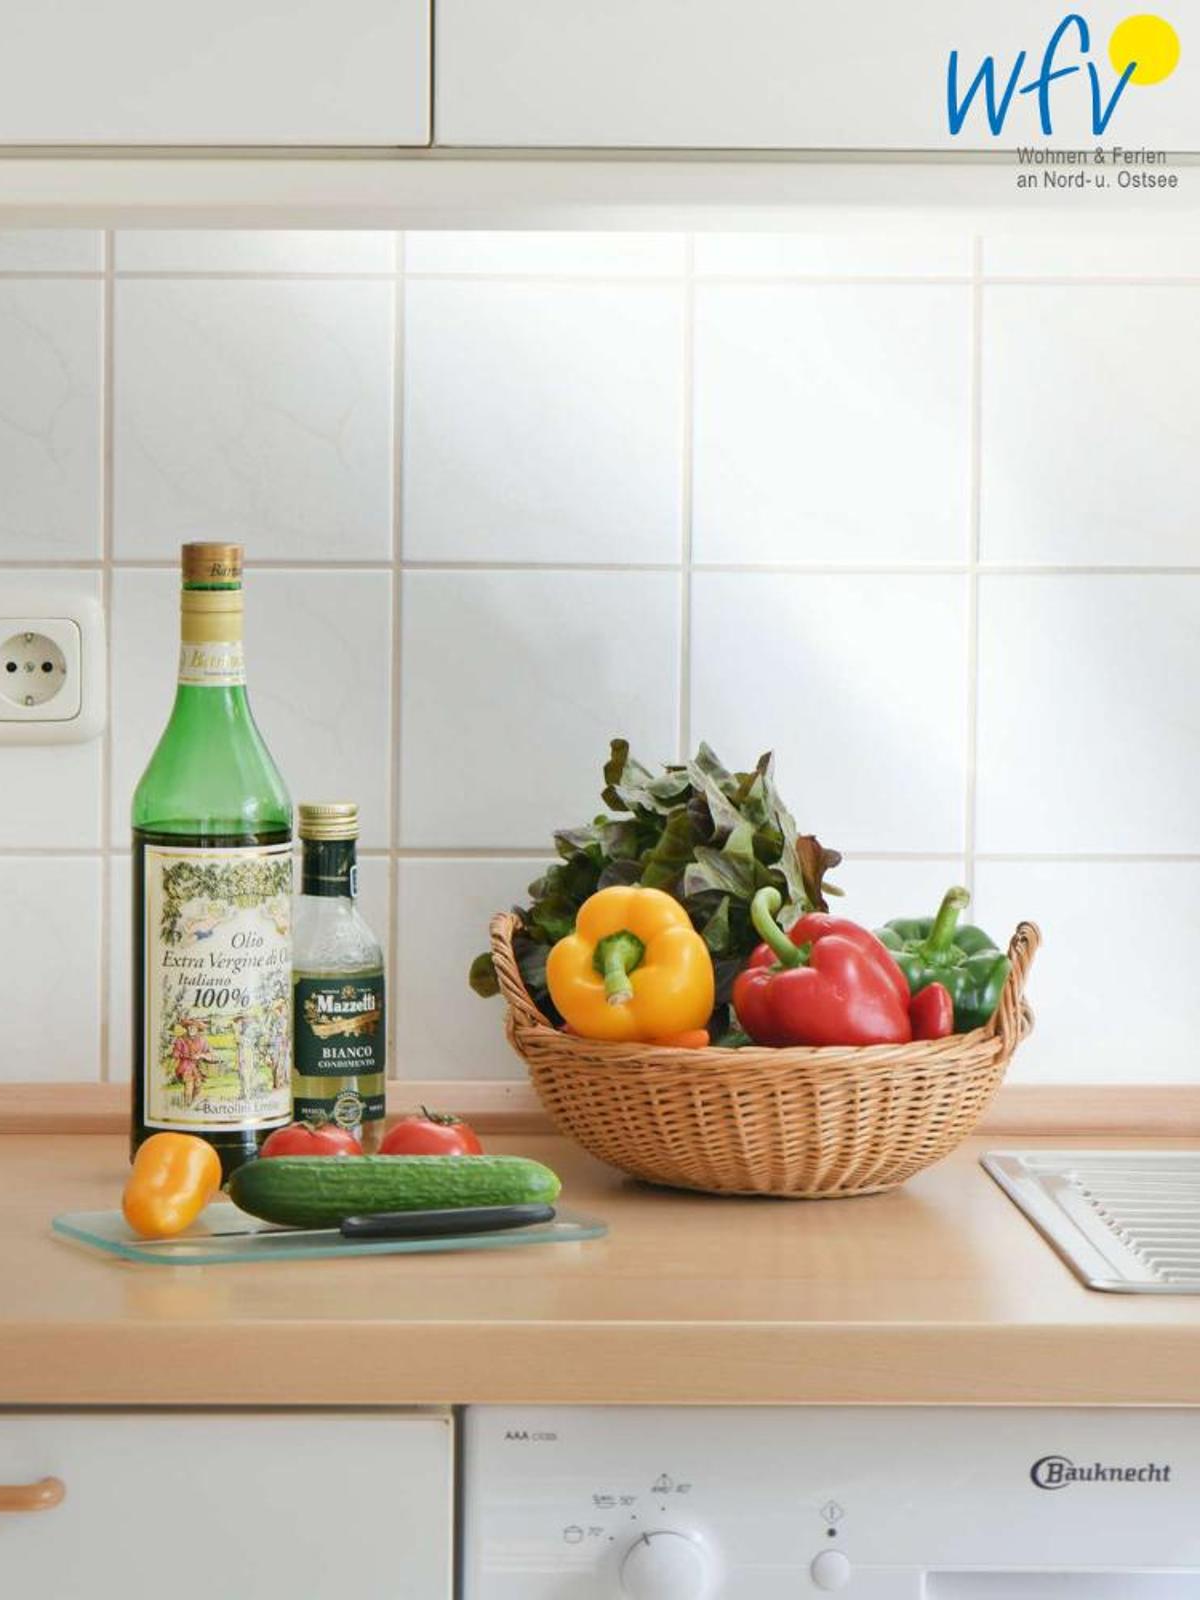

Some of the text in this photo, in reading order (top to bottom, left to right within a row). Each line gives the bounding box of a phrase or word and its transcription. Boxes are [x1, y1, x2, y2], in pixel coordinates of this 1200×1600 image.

[231, 931, 264, 949] Olio
[162, 951, 205, 968] Extra
[209, 952, 265, 974] Vergine
[178, 972, 231, 987] Italiano
[192, 988, 250, 1008] 100%
[317, 993, 376, 1013] Mazzetti
[322, 1046, 372, 1059] BIANCO
[318, 1059, 375, 1070] CONDIMENTO
[1040, 1460, 1171, 1485] Bauknecht
